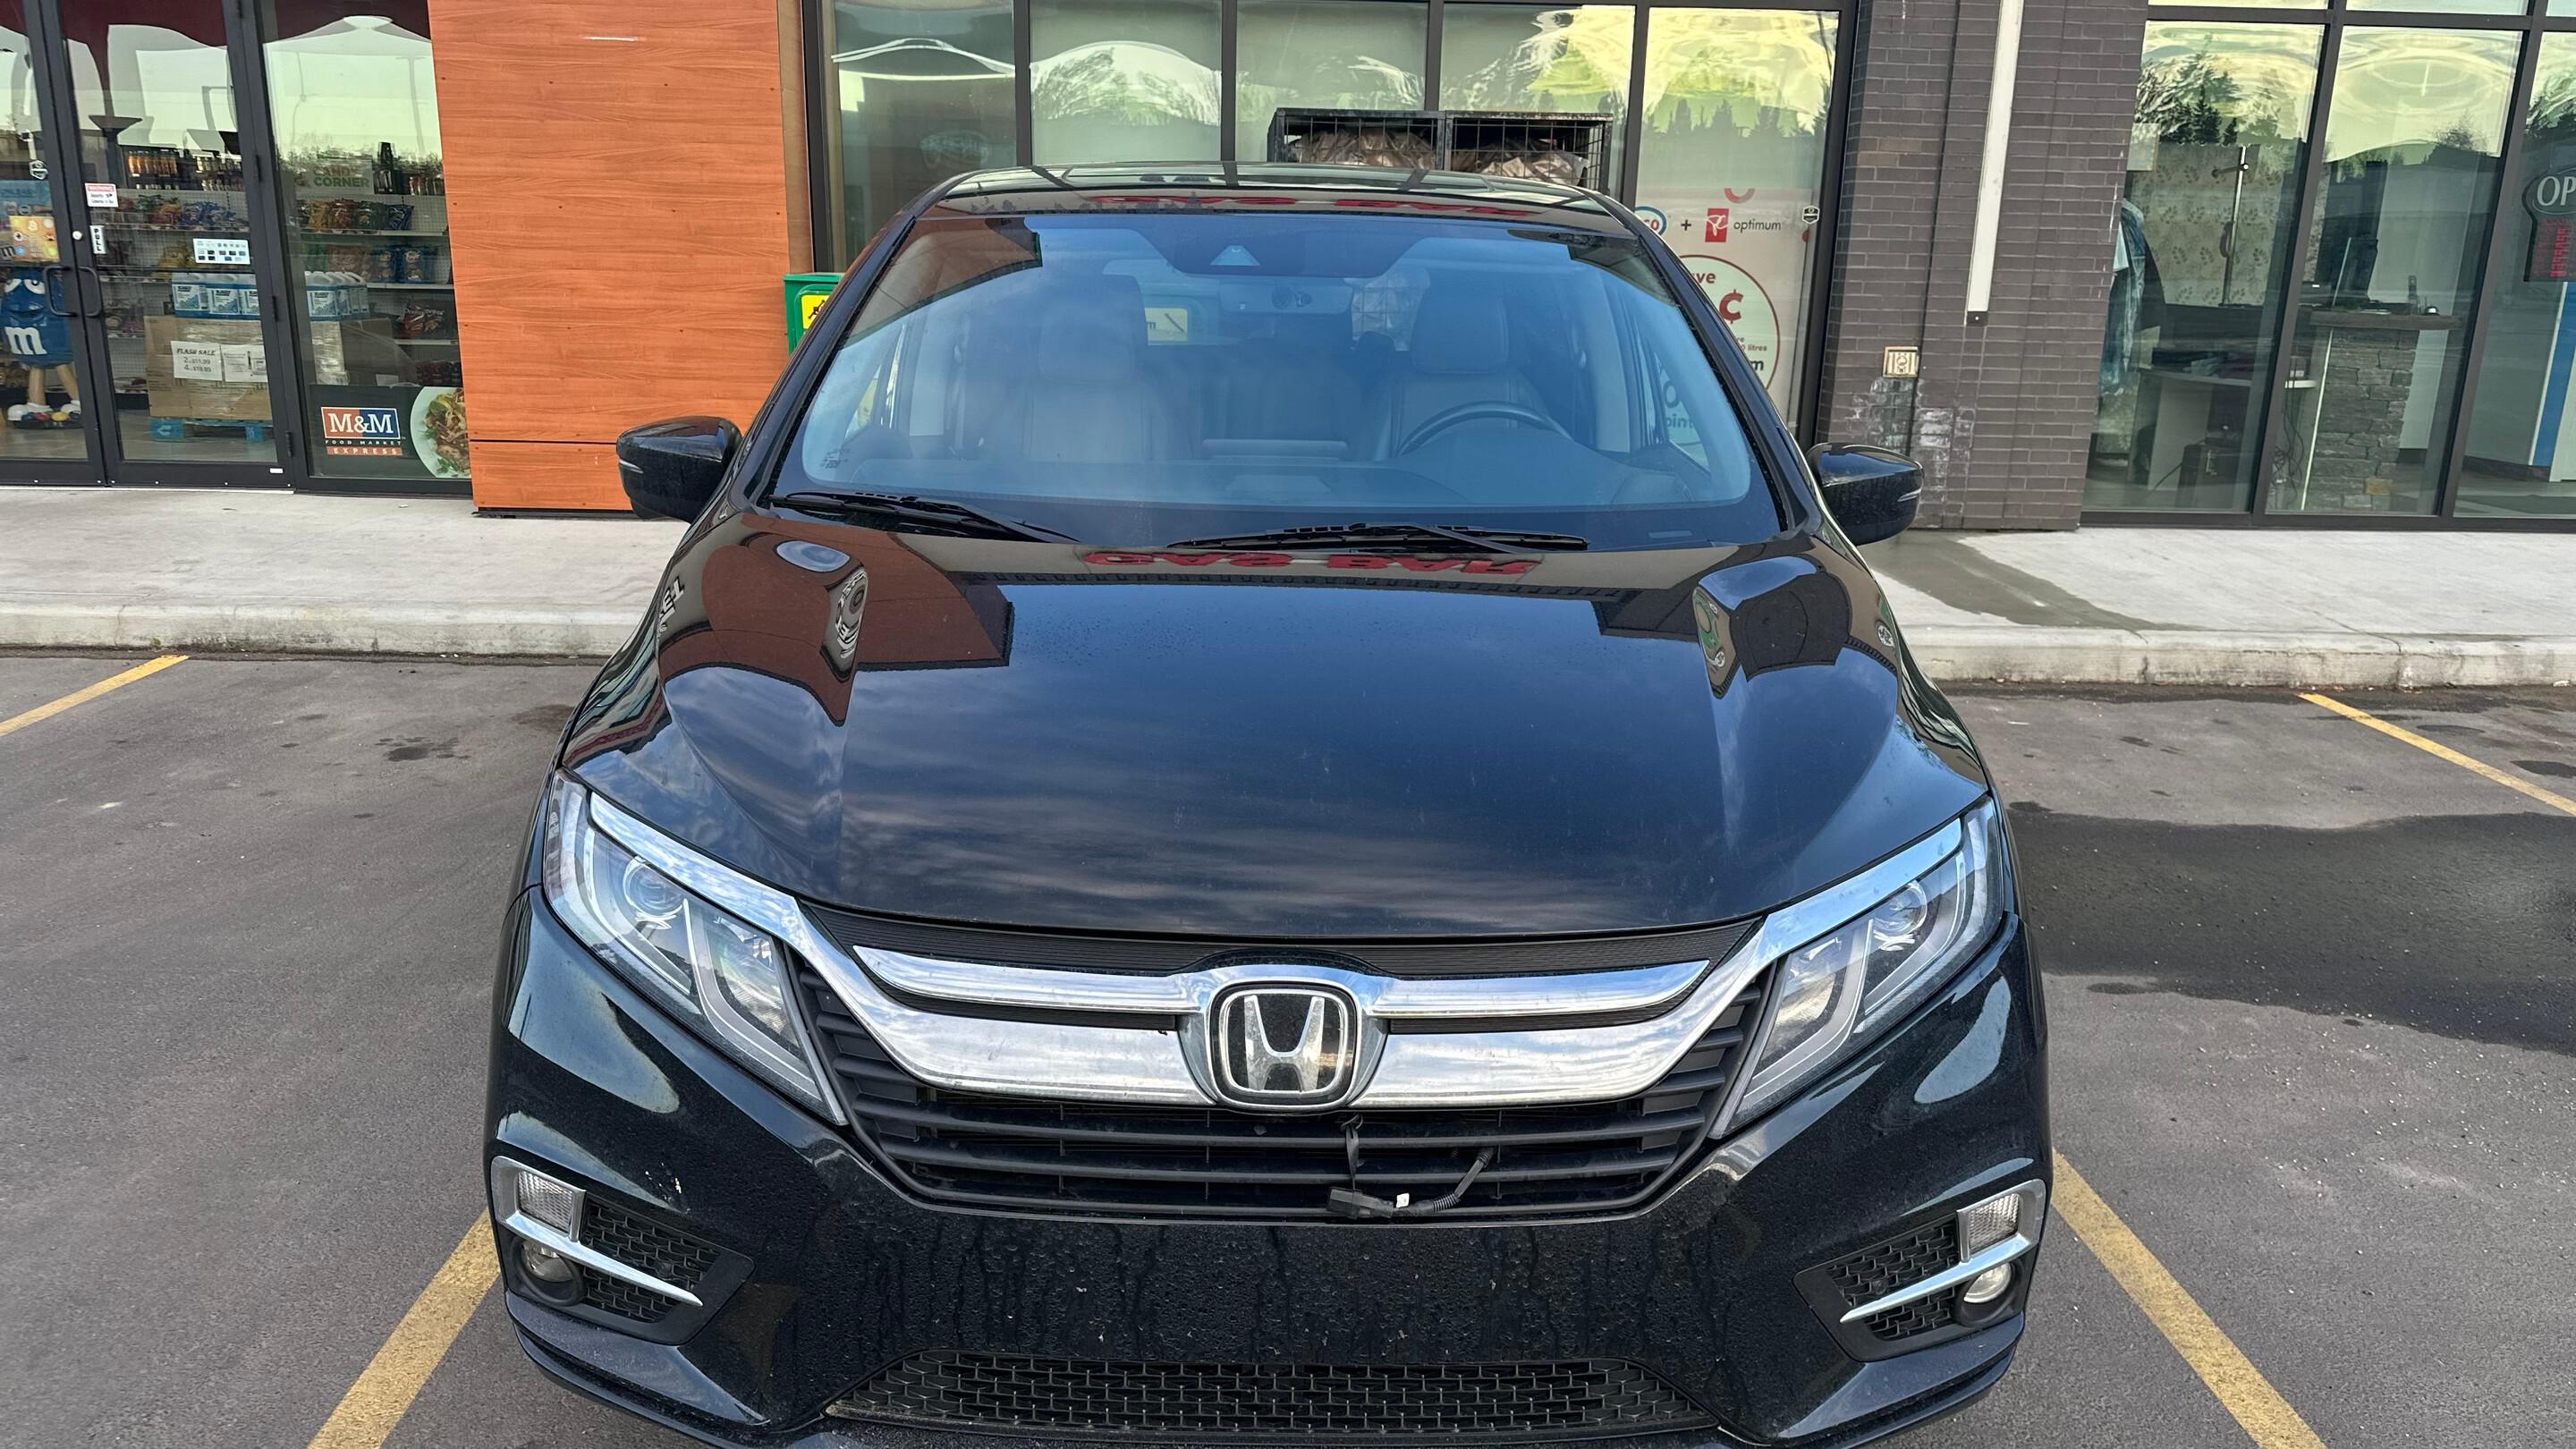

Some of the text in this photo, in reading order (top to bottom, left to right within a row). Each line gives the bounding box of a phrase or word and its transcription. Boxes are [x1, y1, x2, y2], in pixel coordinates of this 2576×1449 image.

[313, 177, 370, 187] CORNER
[1733, 217, 1782, 233] optimum
[93, 228, 102, 251] PULL
[1693, 272, 1716, 284] ve
[4, 326, 47, 355] m
[1748, 343, 1767, 352] litres
[327, 412, 394, 434] M&M
[333, 447, 397, 455] EXPRESS
